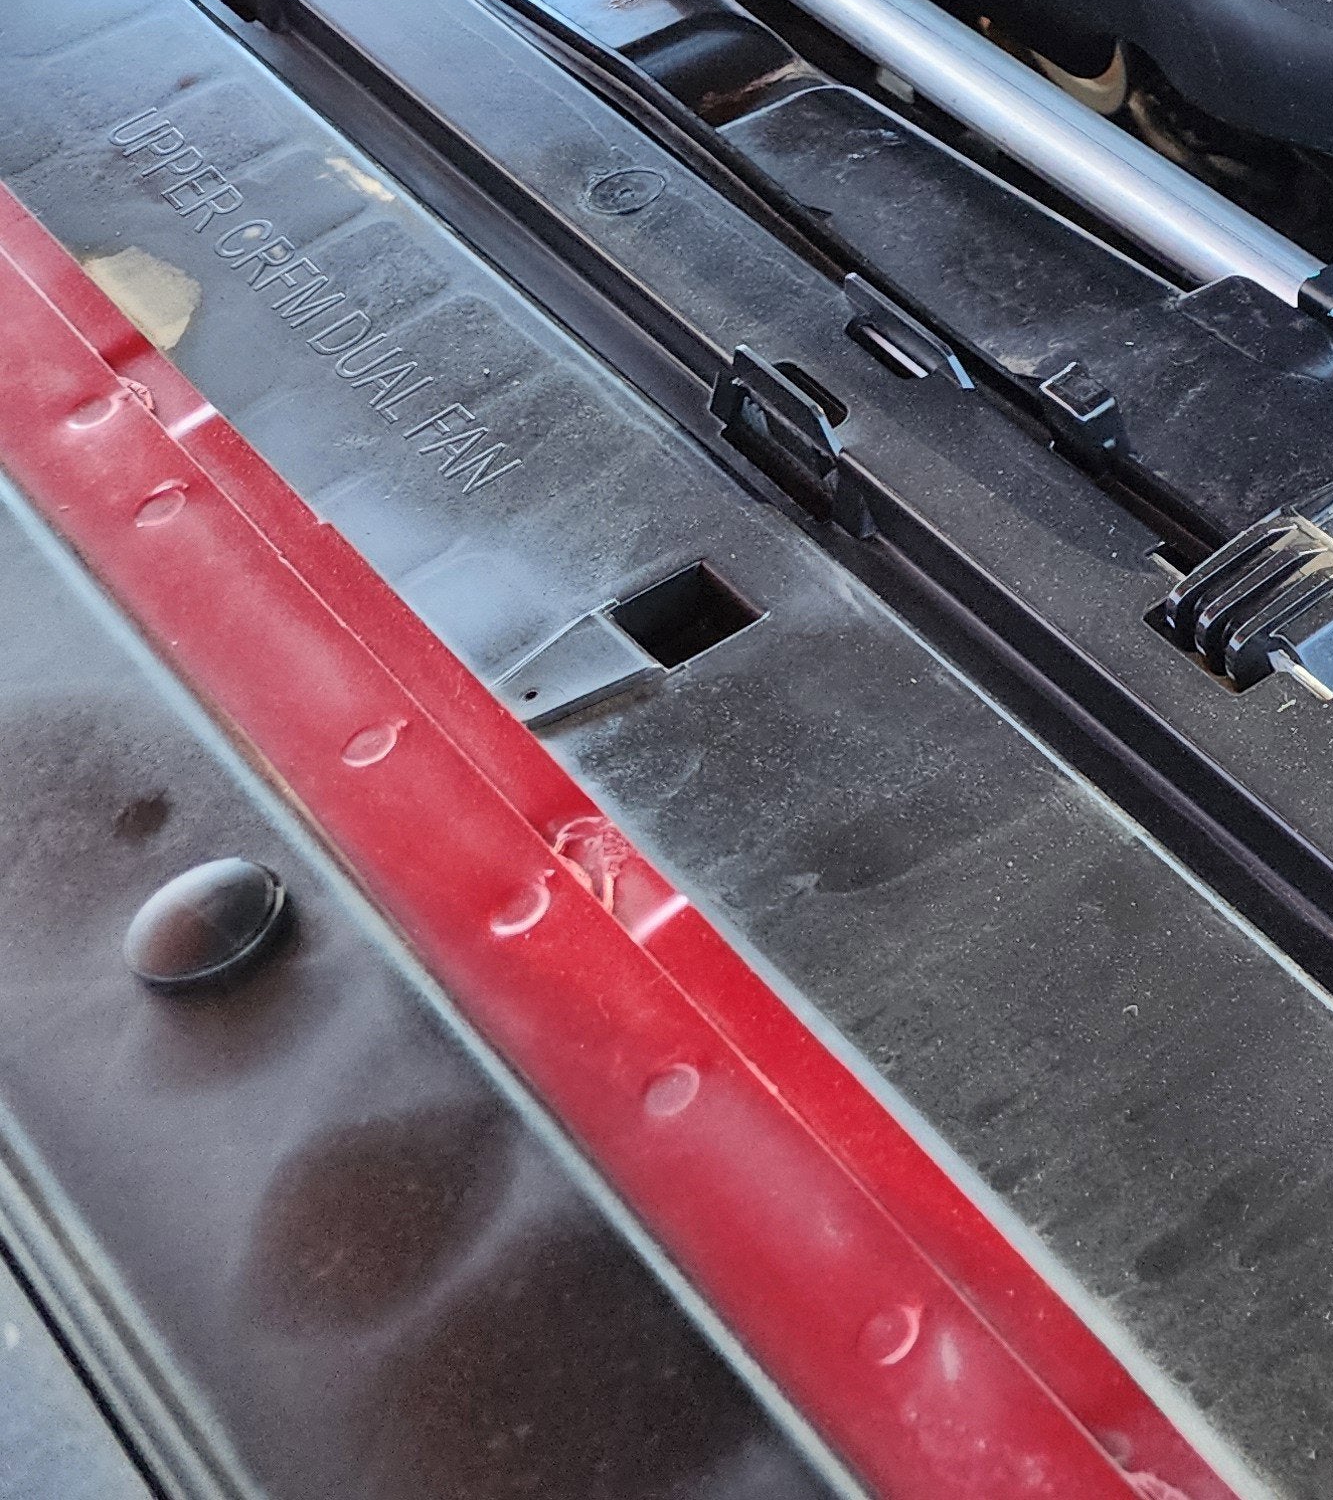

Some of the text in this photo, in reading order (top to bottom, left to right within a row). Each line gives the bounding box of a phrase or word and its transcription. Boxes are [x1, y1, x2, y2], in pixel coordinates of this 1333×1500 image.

[108, 106, 524, 495] UPPER CRFM DUAL FAN
